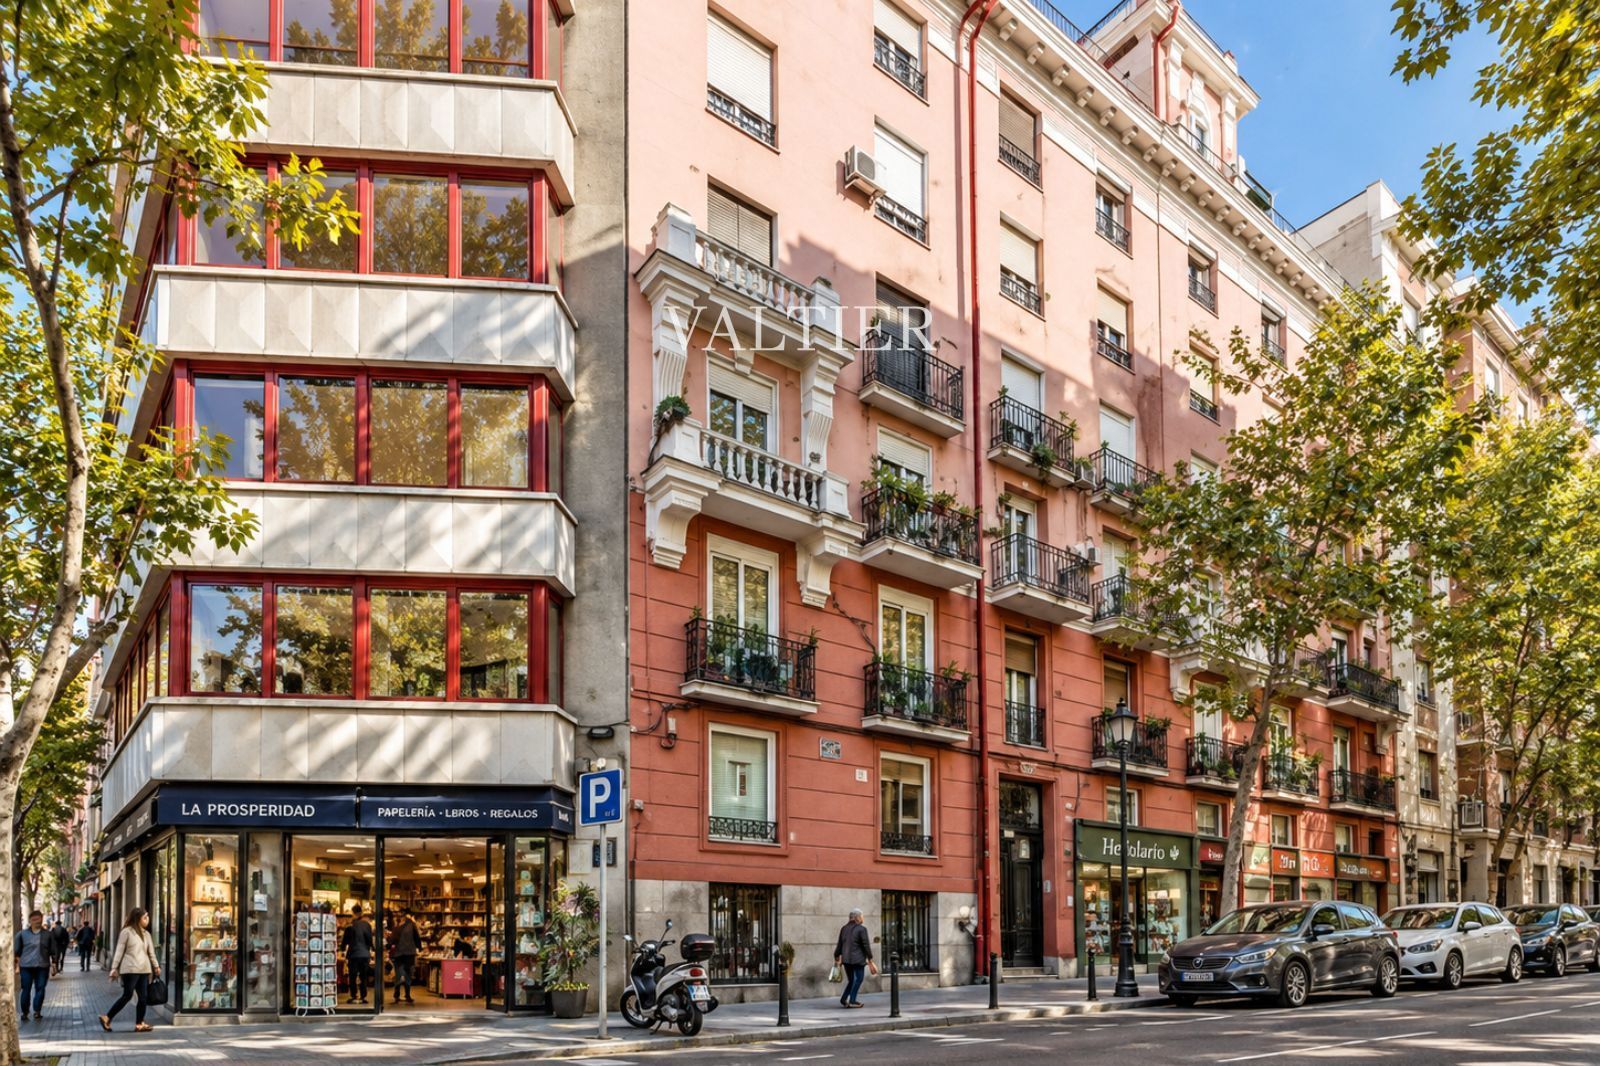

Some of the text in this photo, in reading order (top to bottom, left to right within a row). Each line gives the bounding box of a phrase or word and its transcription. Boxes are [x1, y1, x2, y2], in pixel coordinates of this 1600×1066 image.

[589, 776, 612, 819] P
[181, 803, 316, 817] LA PROSPERIDAD
[377, 805, 436, 818] PAPELERÍA
[490, 809, 539, 819] REGALOS
